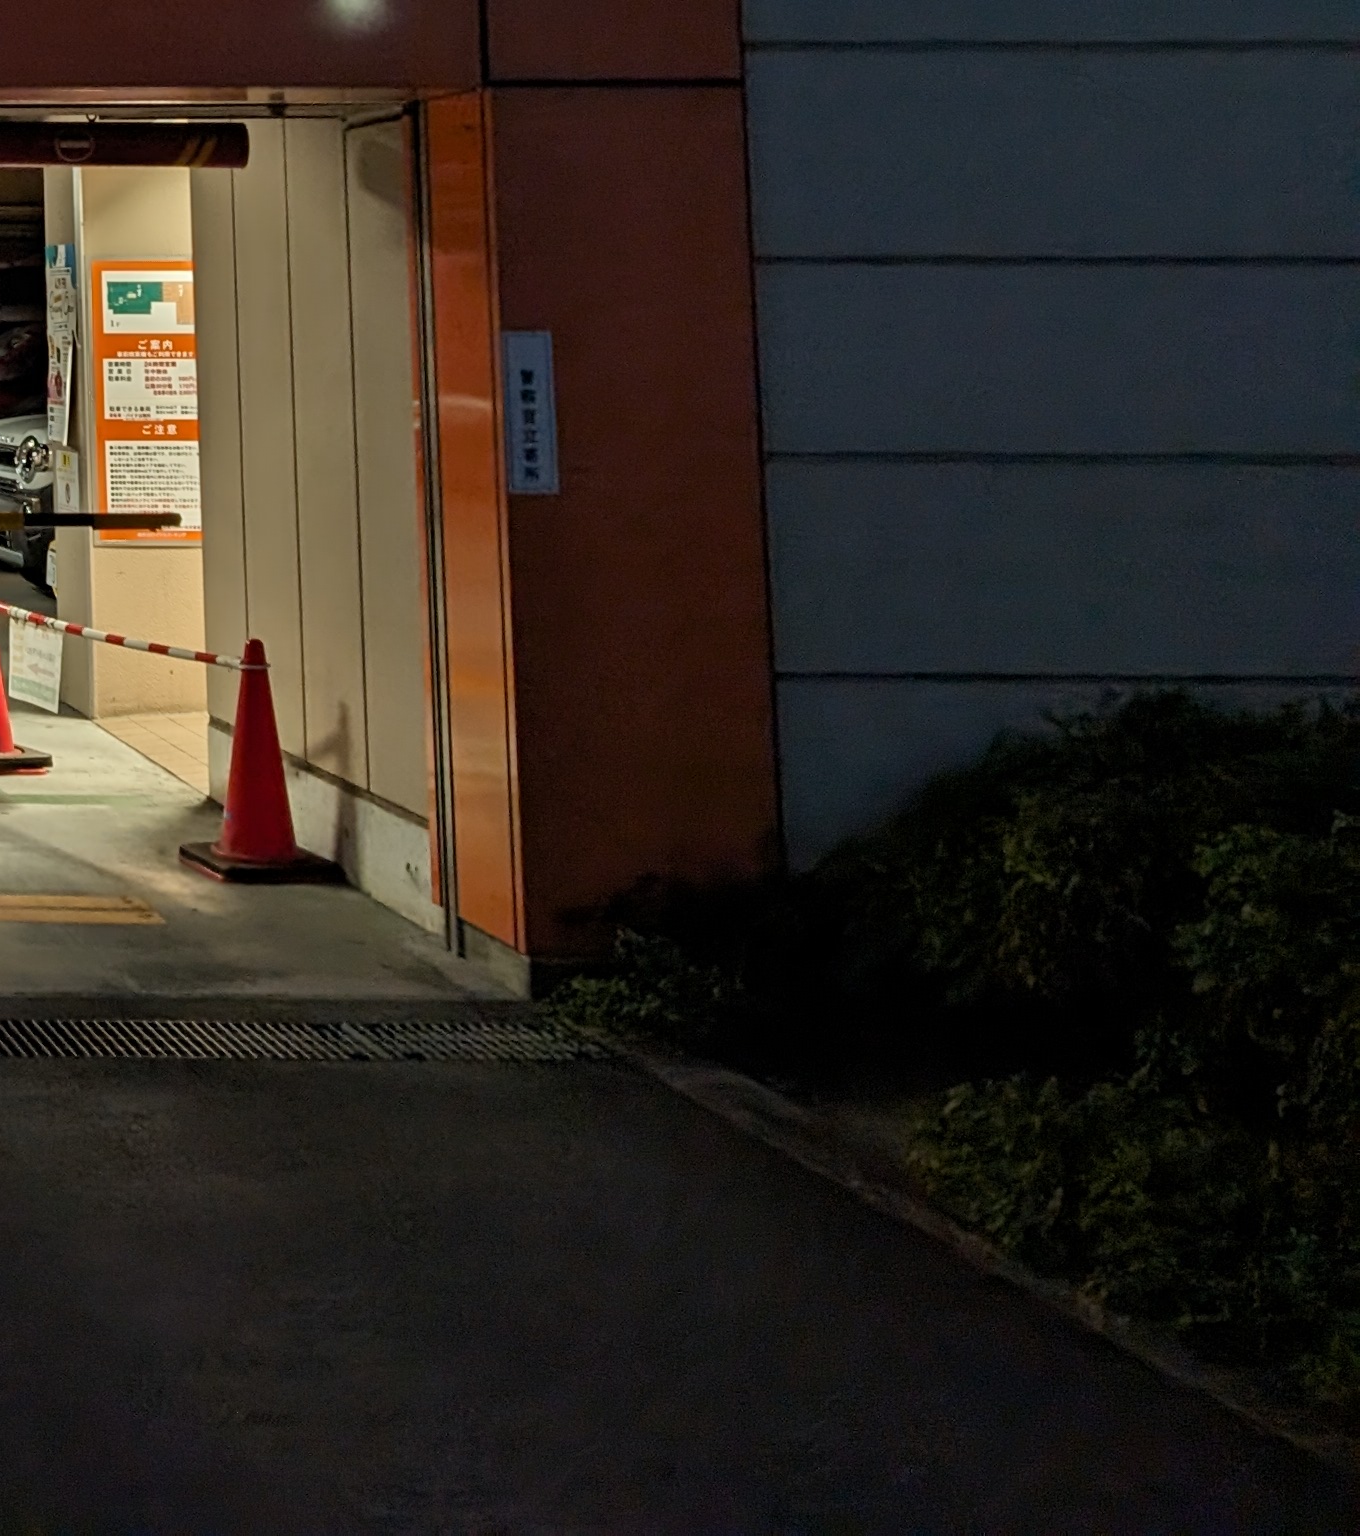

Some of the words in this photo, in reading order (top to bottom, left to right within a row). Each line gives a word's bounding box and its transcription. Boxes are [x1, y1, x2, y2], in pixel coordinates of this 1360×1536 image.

[137, 339, 173, 350] ご案内
[141, 424, 177, 435] ご注意
